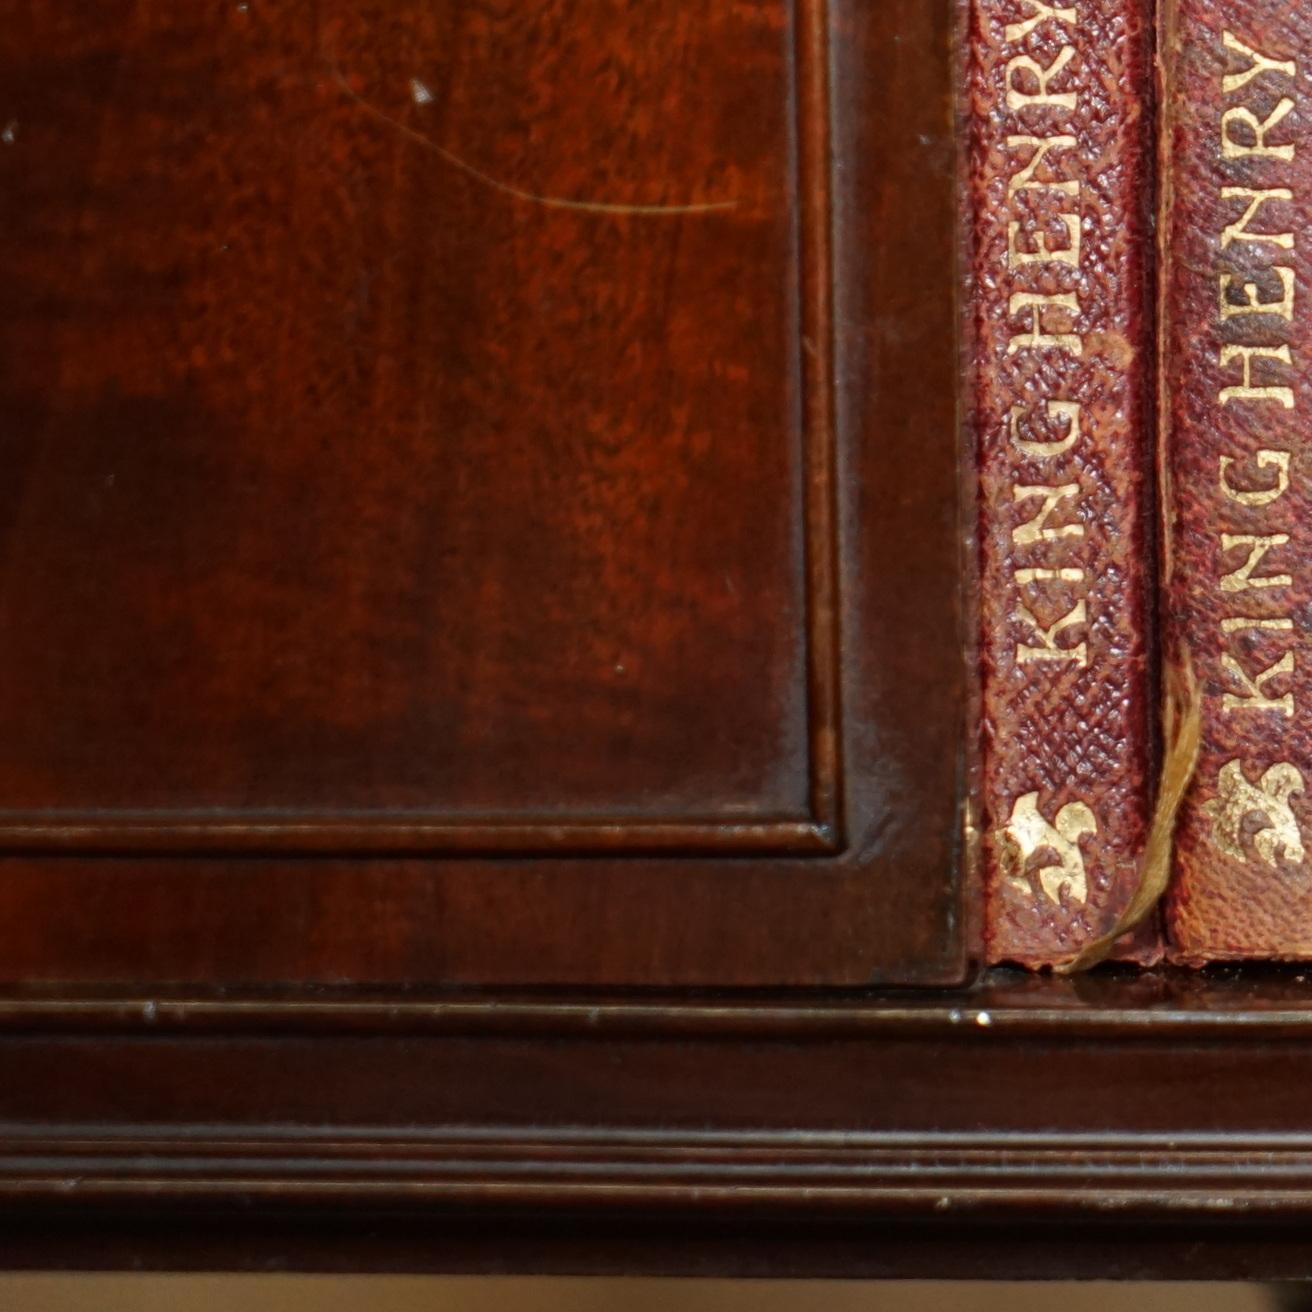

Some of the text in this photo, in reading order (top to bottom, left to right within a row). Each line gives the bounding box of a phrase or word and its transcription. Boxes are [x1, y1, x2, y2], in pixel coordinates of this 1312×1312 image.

[1219, 32, 1297, 409] HENRY
[1010, 400, 1089, 669] KING
[1219, 450, 1295, 717] KING
